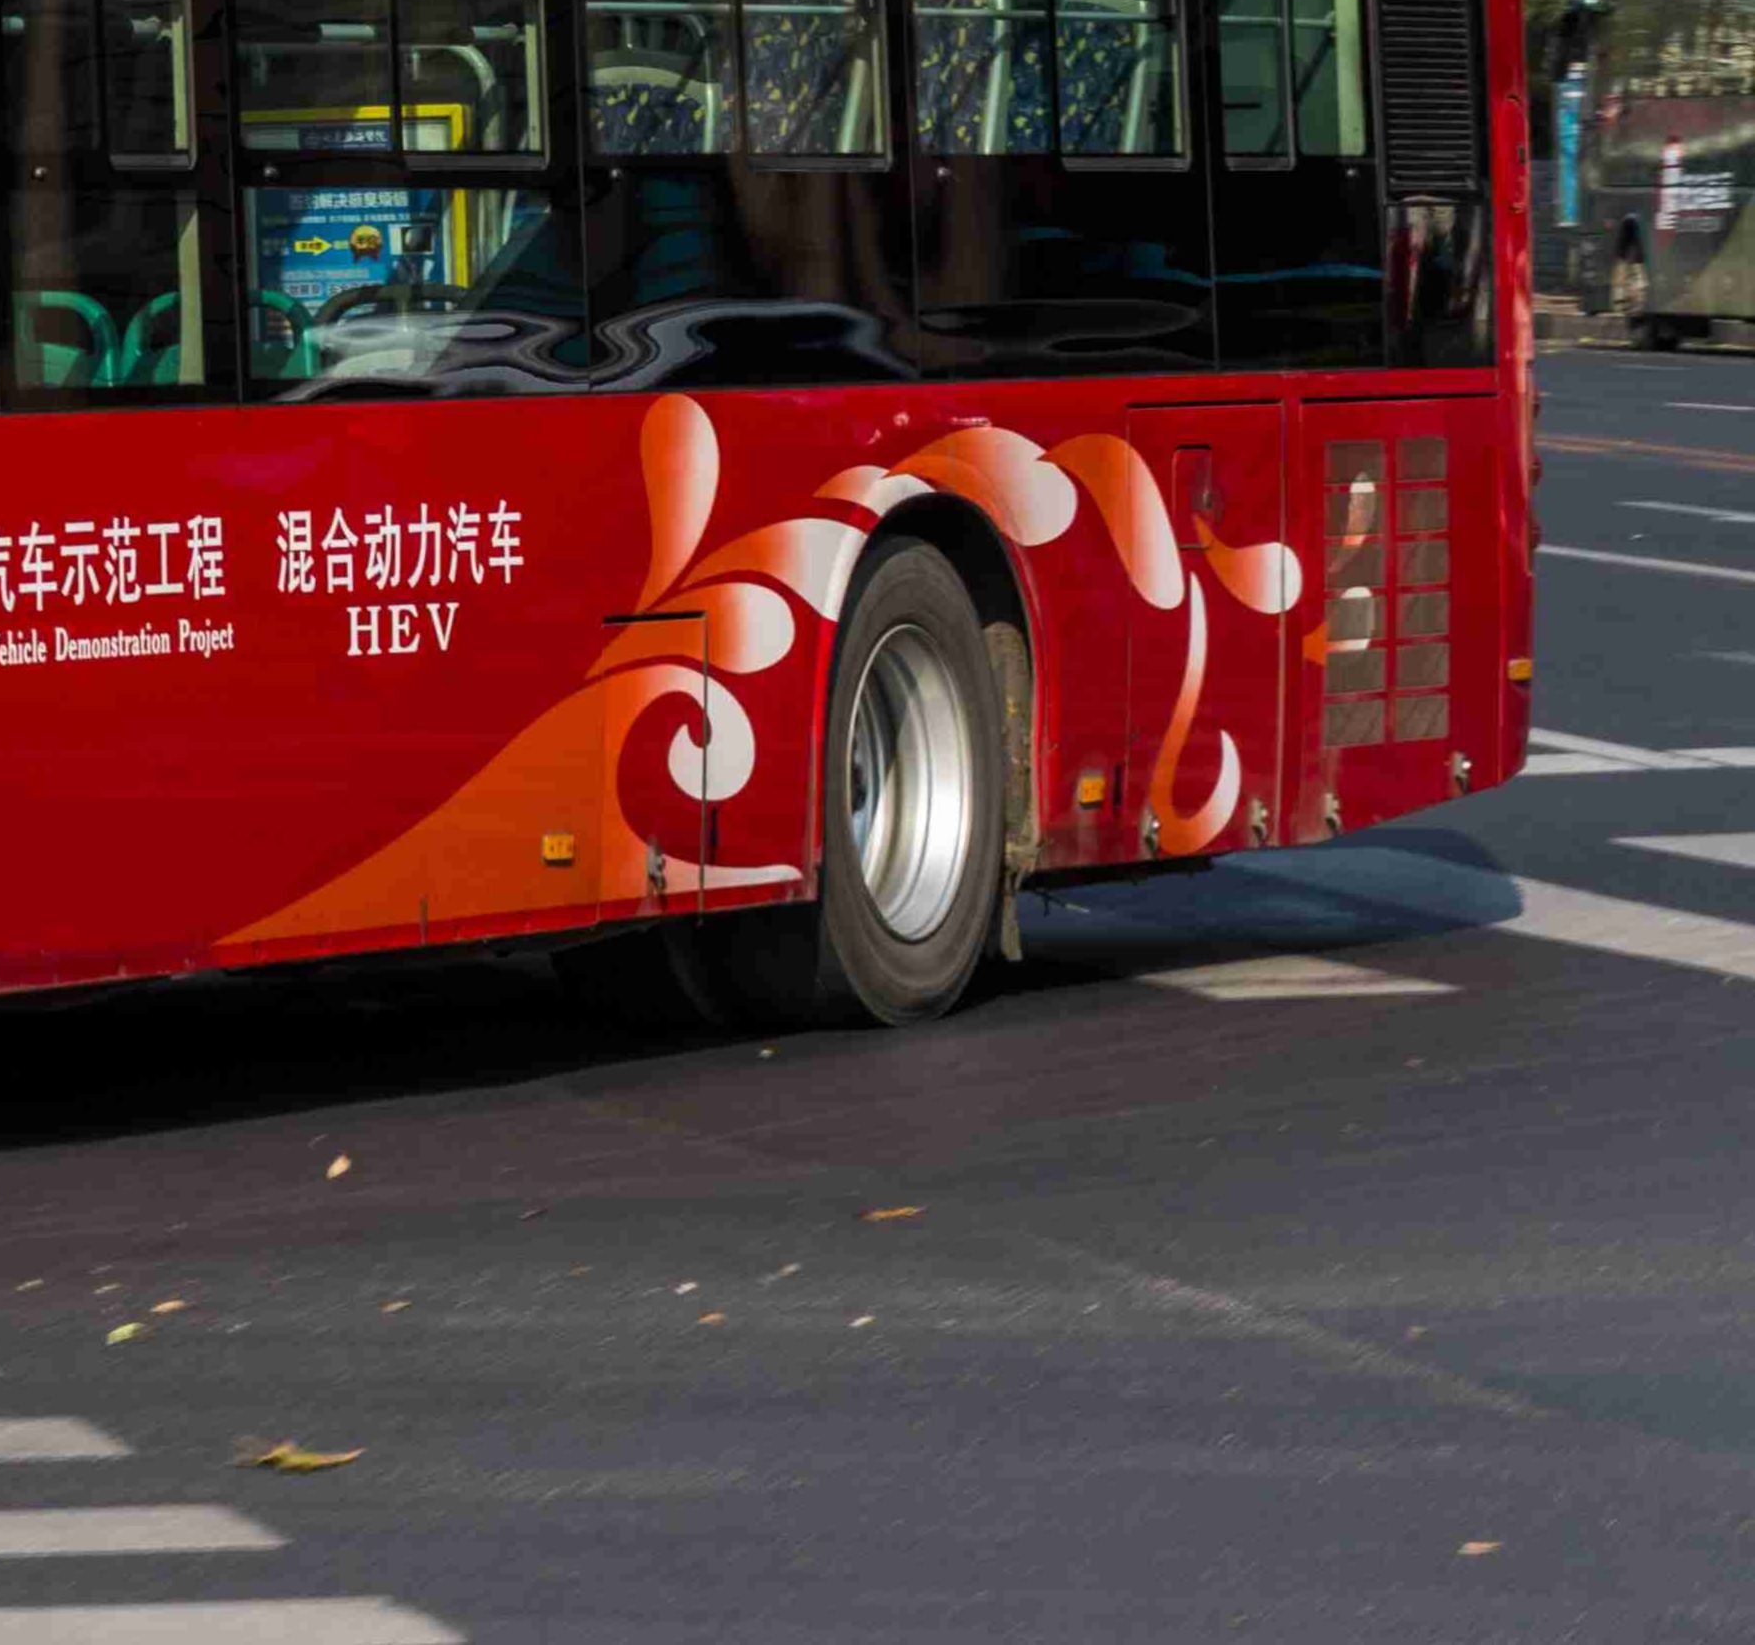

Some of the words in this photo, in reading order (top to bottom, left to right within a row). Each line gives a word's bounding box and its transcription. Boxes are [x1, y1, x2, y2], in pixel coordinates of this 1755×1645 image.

[276, 499, 525, 594] 混合动力汽车
[54, 622, 171, 661] Demonstration
[178, 618, 235, 658] Project
[346, 602, 460, 656] HEV
